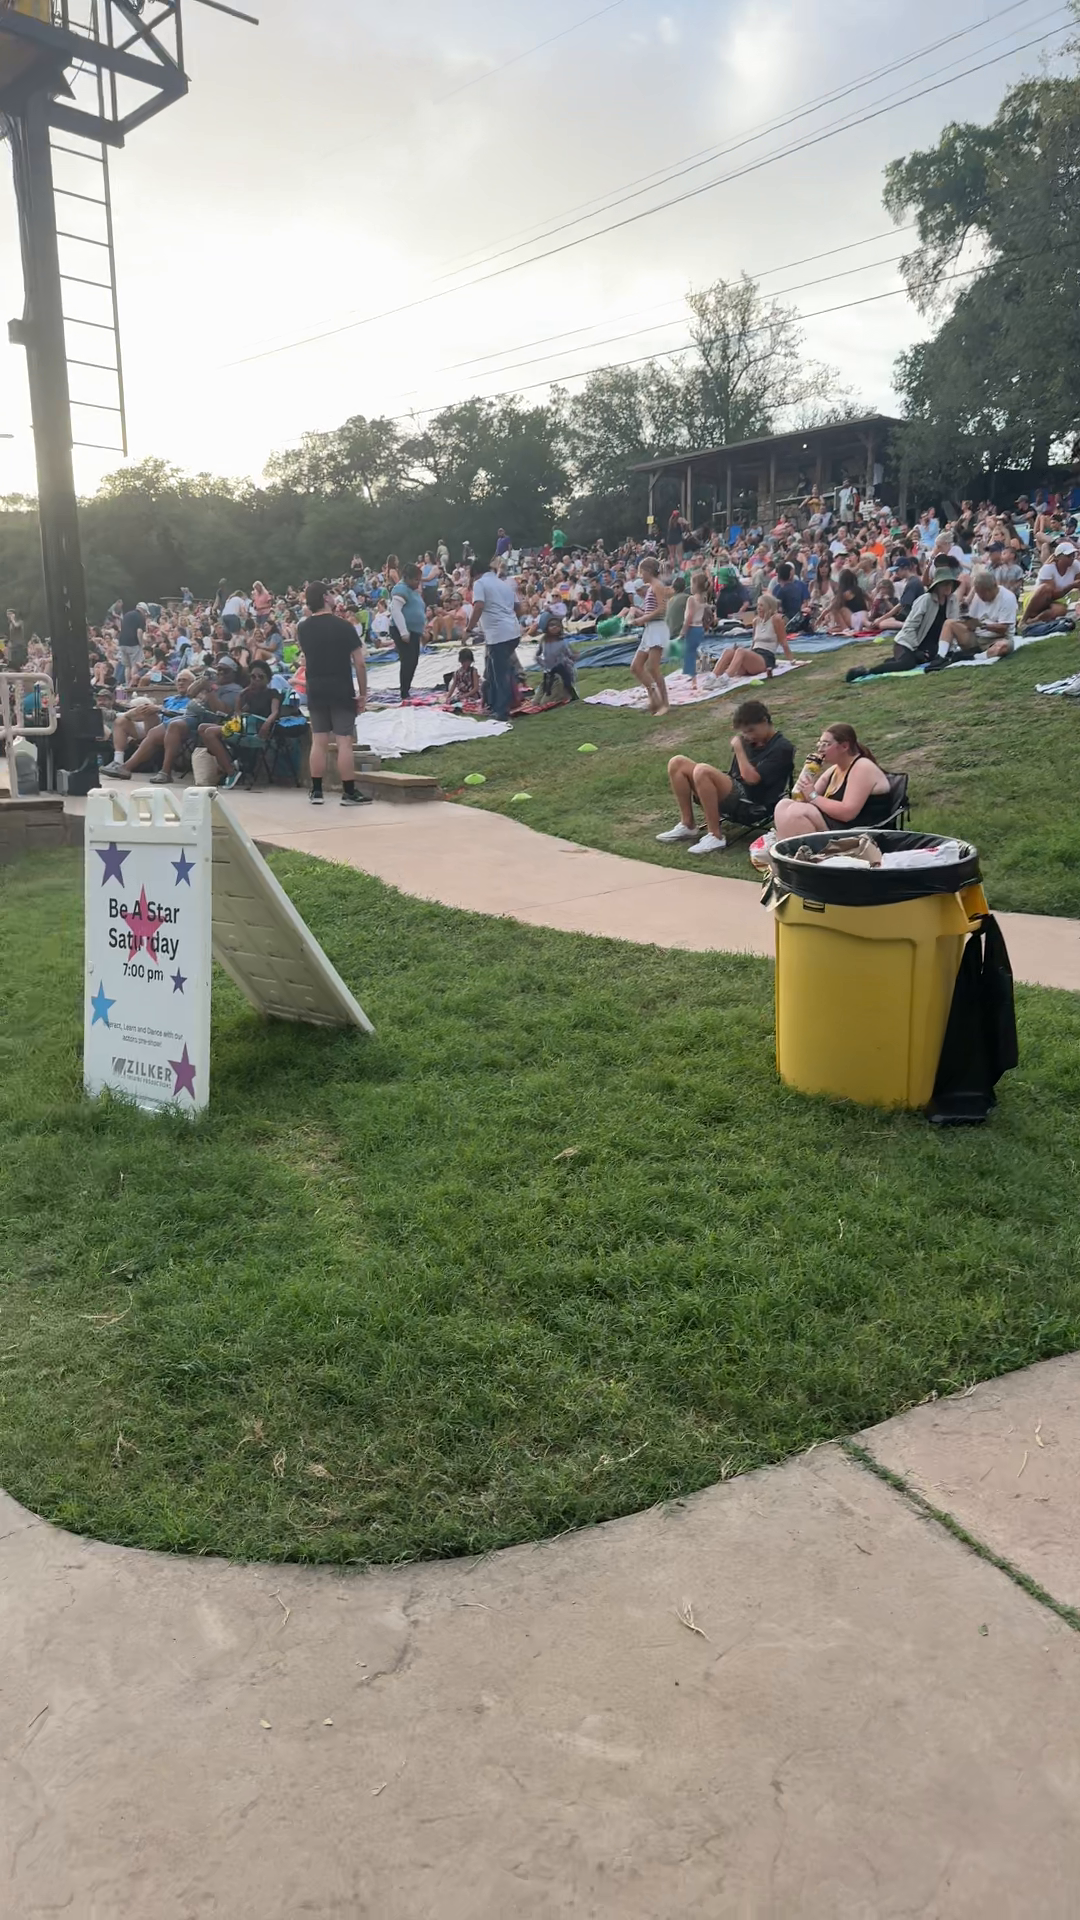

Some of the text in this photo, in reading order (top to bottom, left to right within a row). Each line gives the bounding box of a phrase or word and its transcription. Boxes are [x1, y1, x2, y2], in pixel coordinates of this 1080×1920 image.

[109, 898, 180, 923] Be A Star
[123, 963, 164, 983] 7:00 pm
[123, 1023, 137, 1032] Learn
[137, 1026, 147, 1034] and
[147, 1027, 162, 1037] Dance
[163, 1030, 174, 1038] with
[127, 1060, 172, 1082] ZILKER
